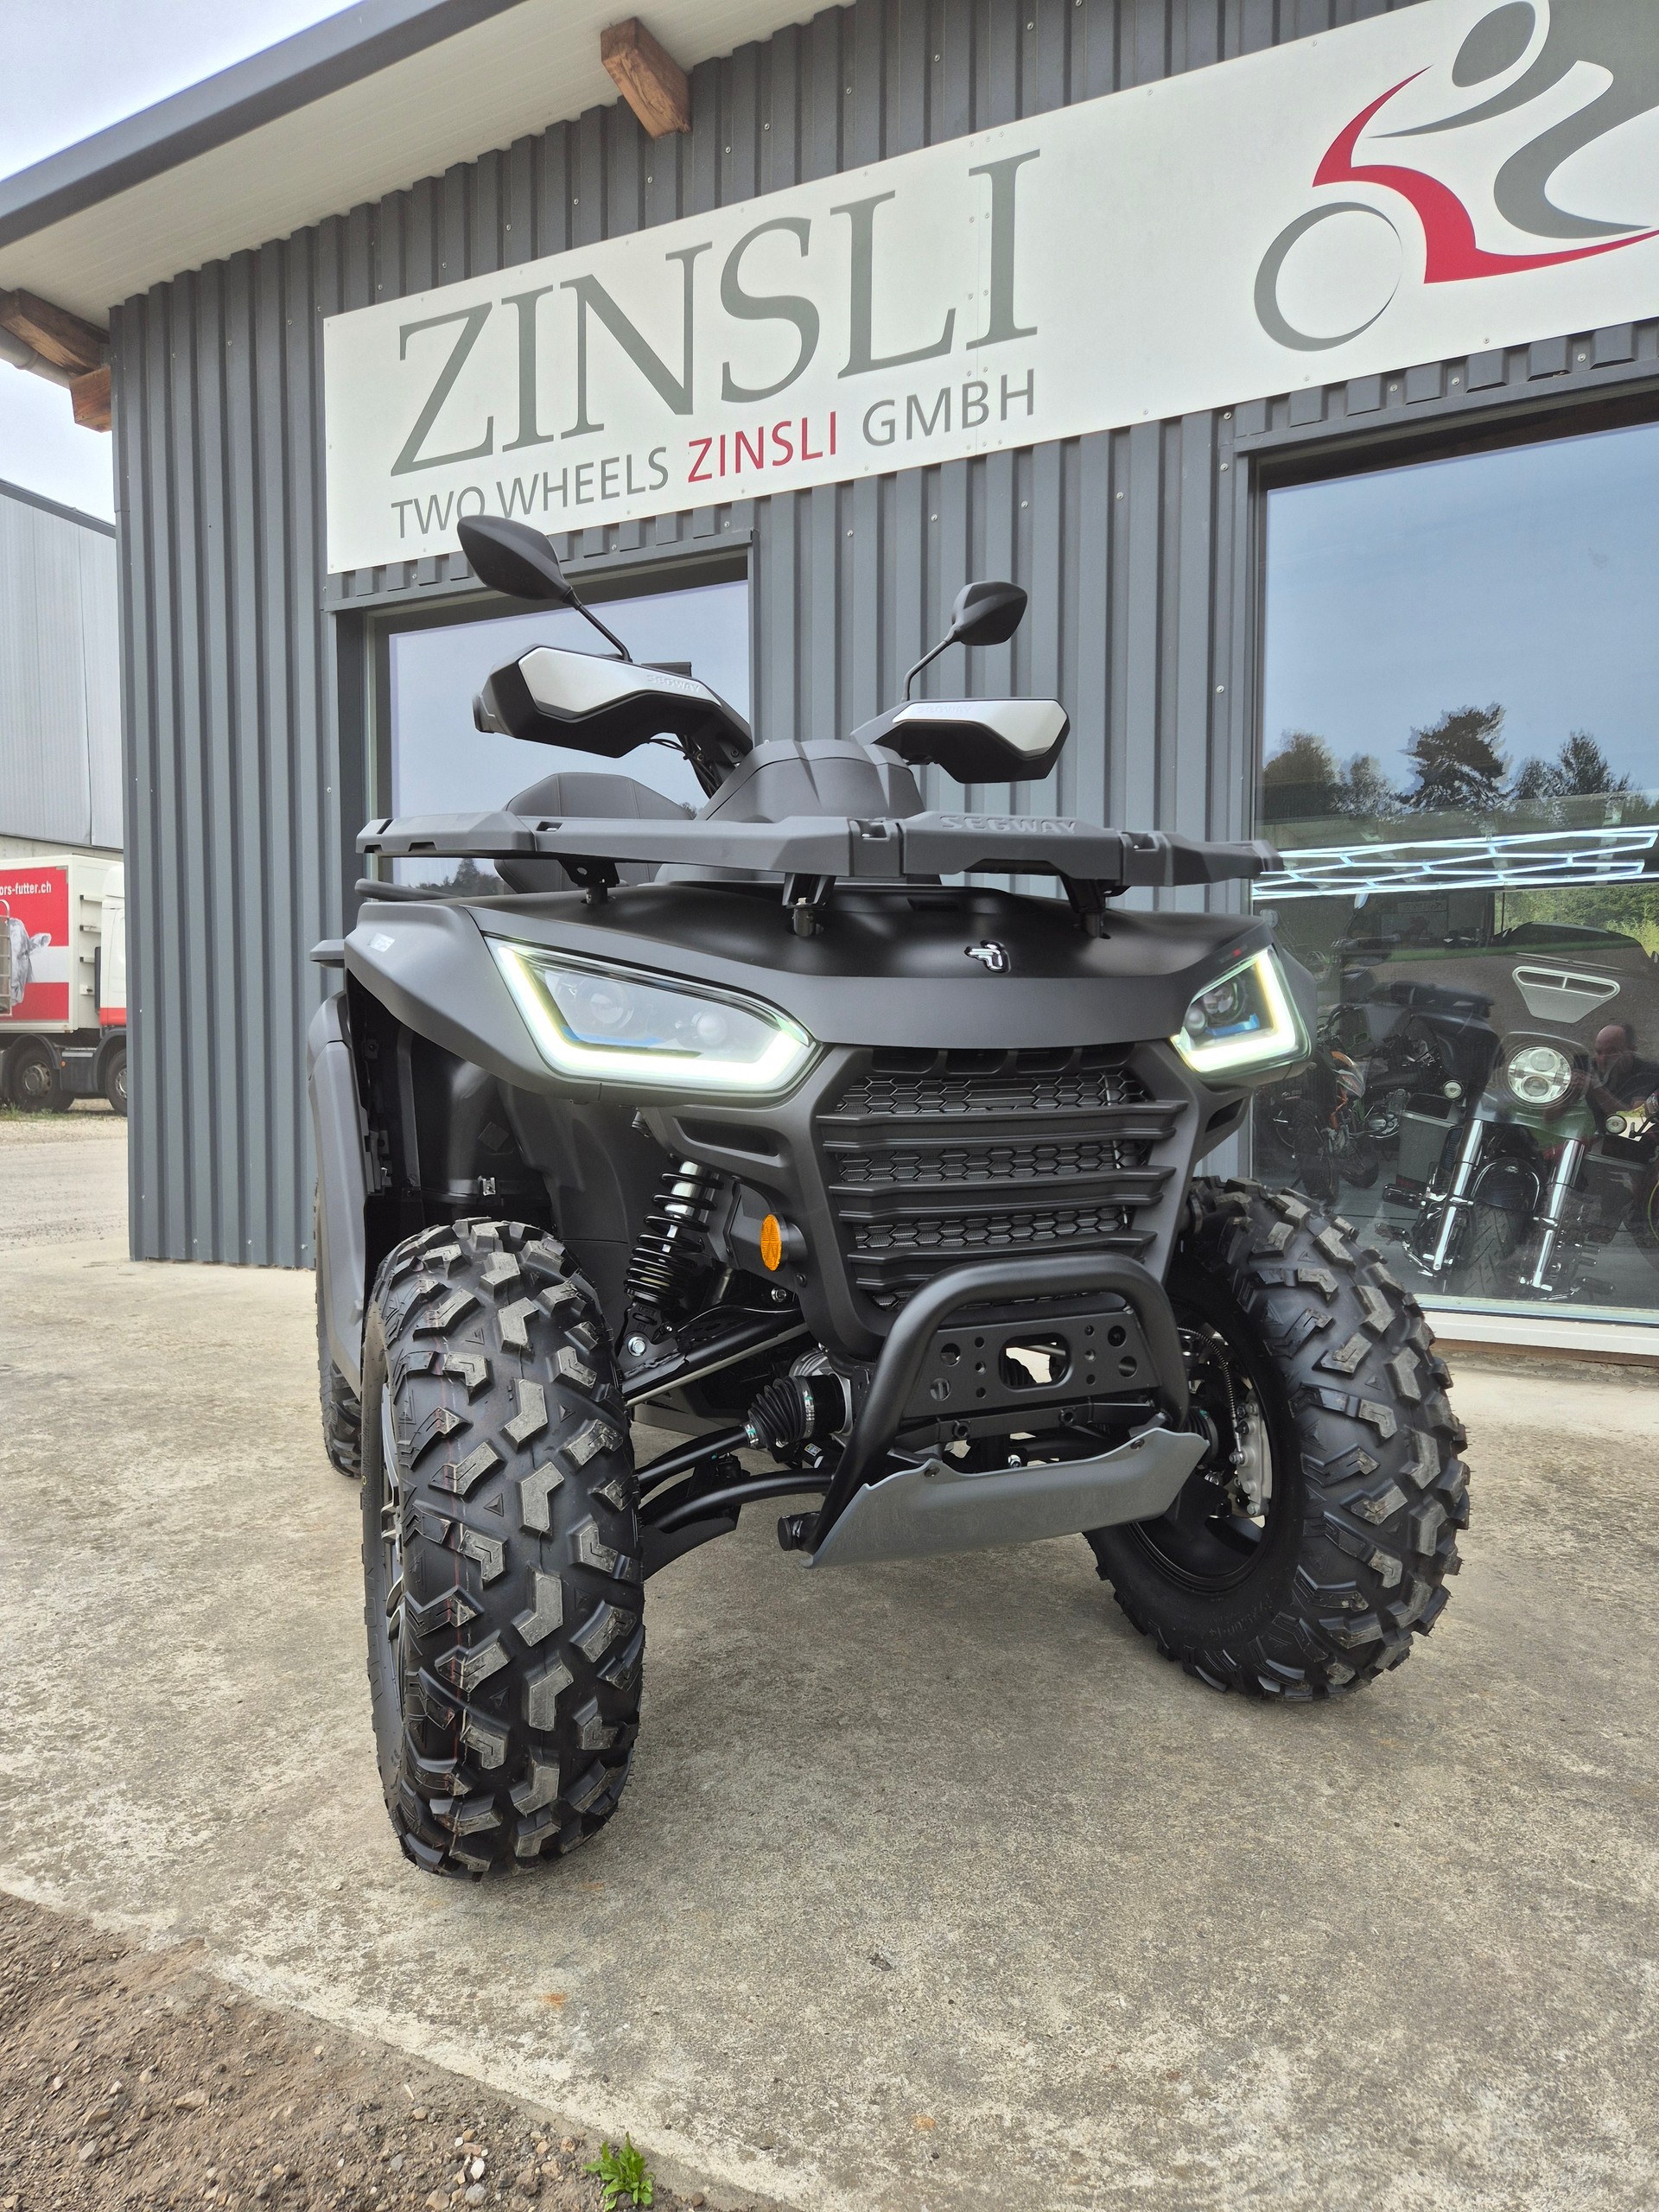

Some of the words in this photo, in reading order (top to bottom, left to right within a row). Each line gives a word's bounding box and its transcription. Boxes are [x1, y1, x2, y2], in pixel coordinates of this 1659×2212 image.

[391, 149, 1040, 476] ZINSLI
[391, 486, 486, 539] TWO
[496, 447, 669, 518] WHEELS
[688, 410, 837, 483] ZINSLI
[862, 368, 1035, 447] GMBH
[646, 674, 701, 693] SEGWAY
[940, 816, 1077, 835] SEGWAY
